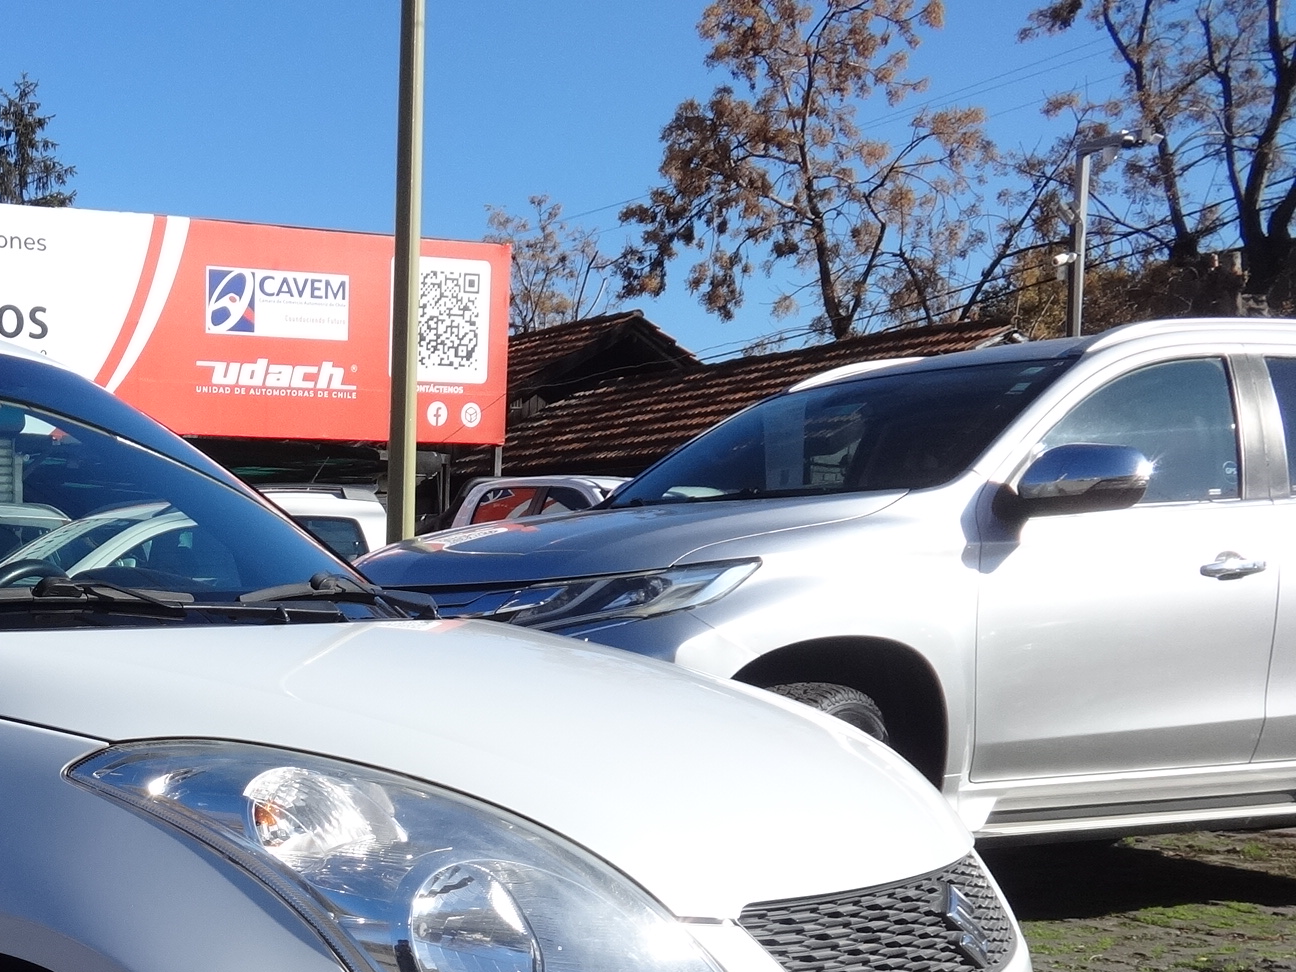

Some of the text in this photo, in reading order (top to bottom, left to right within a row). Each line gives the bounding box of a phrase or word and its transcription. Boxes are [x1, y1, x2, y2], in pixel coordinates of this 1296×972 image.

[259, 275, 346, 300] CAVEM
[195, 358, 357, 391] udach
[195, 385, 357, 400] UNIDAD DE AUTOMOTORAS DE CHILE
[416, 384, 464, 394] ONTÁCTENOS
